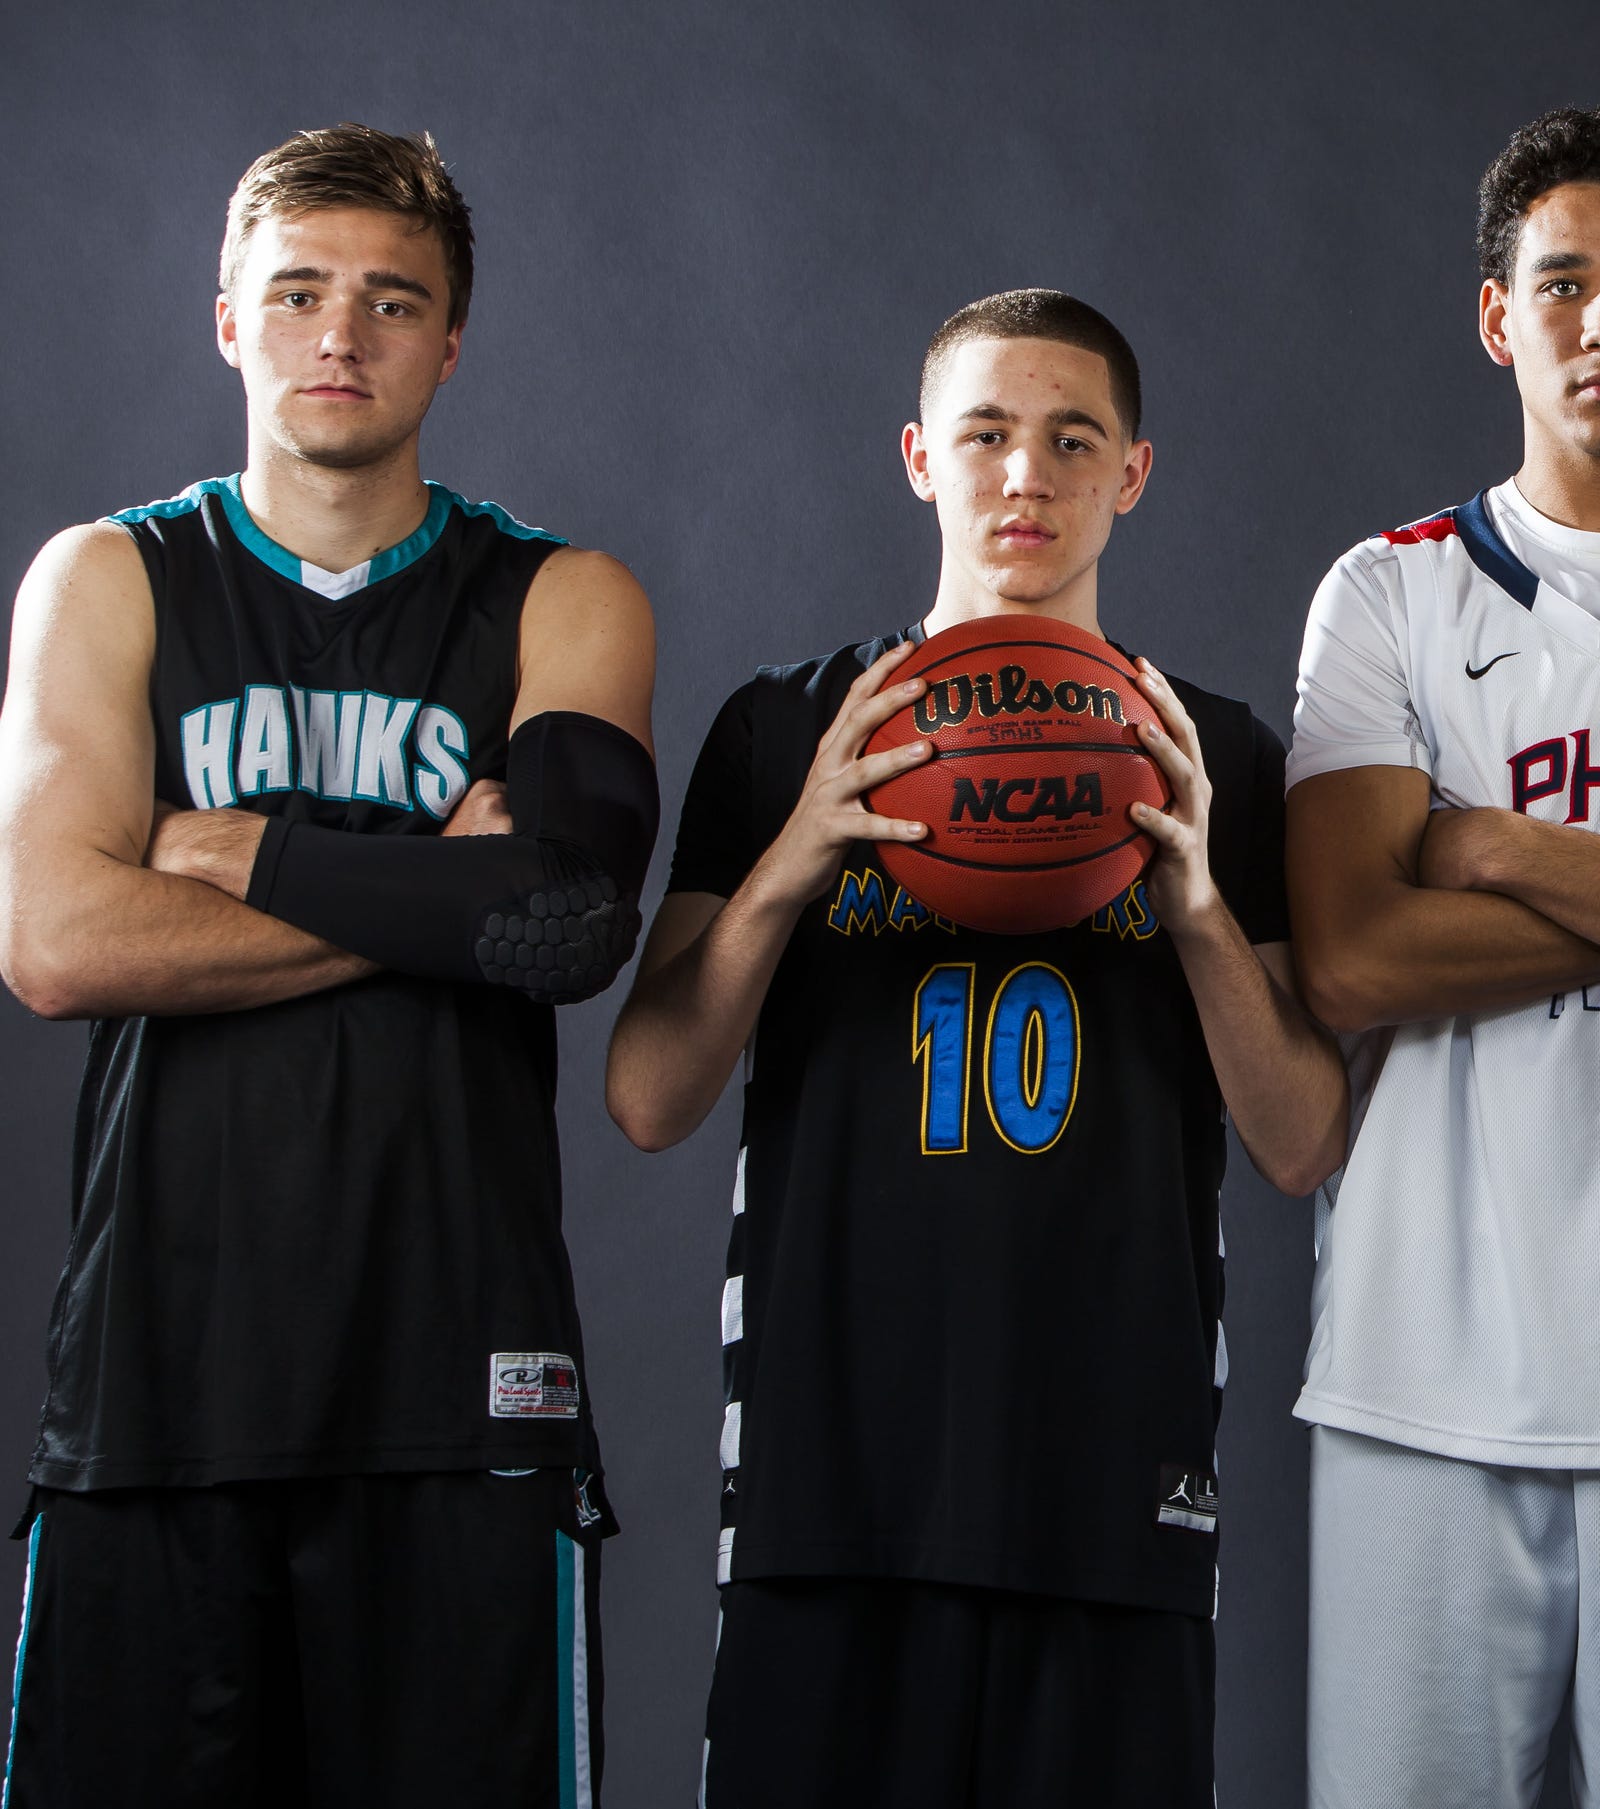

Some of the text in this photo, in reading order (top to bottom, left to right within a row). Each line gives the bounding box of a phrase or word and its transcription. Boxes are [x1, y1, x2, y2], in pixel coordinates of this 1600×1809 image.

[913, 664, 1127, 735] Wilson
[1023, 719, 1053, 727] GAME
[1056, 719, 1081, 727] BALL
[181, 681, 470, 821] HAWKS
[949, 772, 1104, 823] NCAA
[948, 823, 1103, 836] OFFICIAL GAME BALL
[912, 961, 1081, 1155] 10
[1206, 1480, 1214, 1496] L
